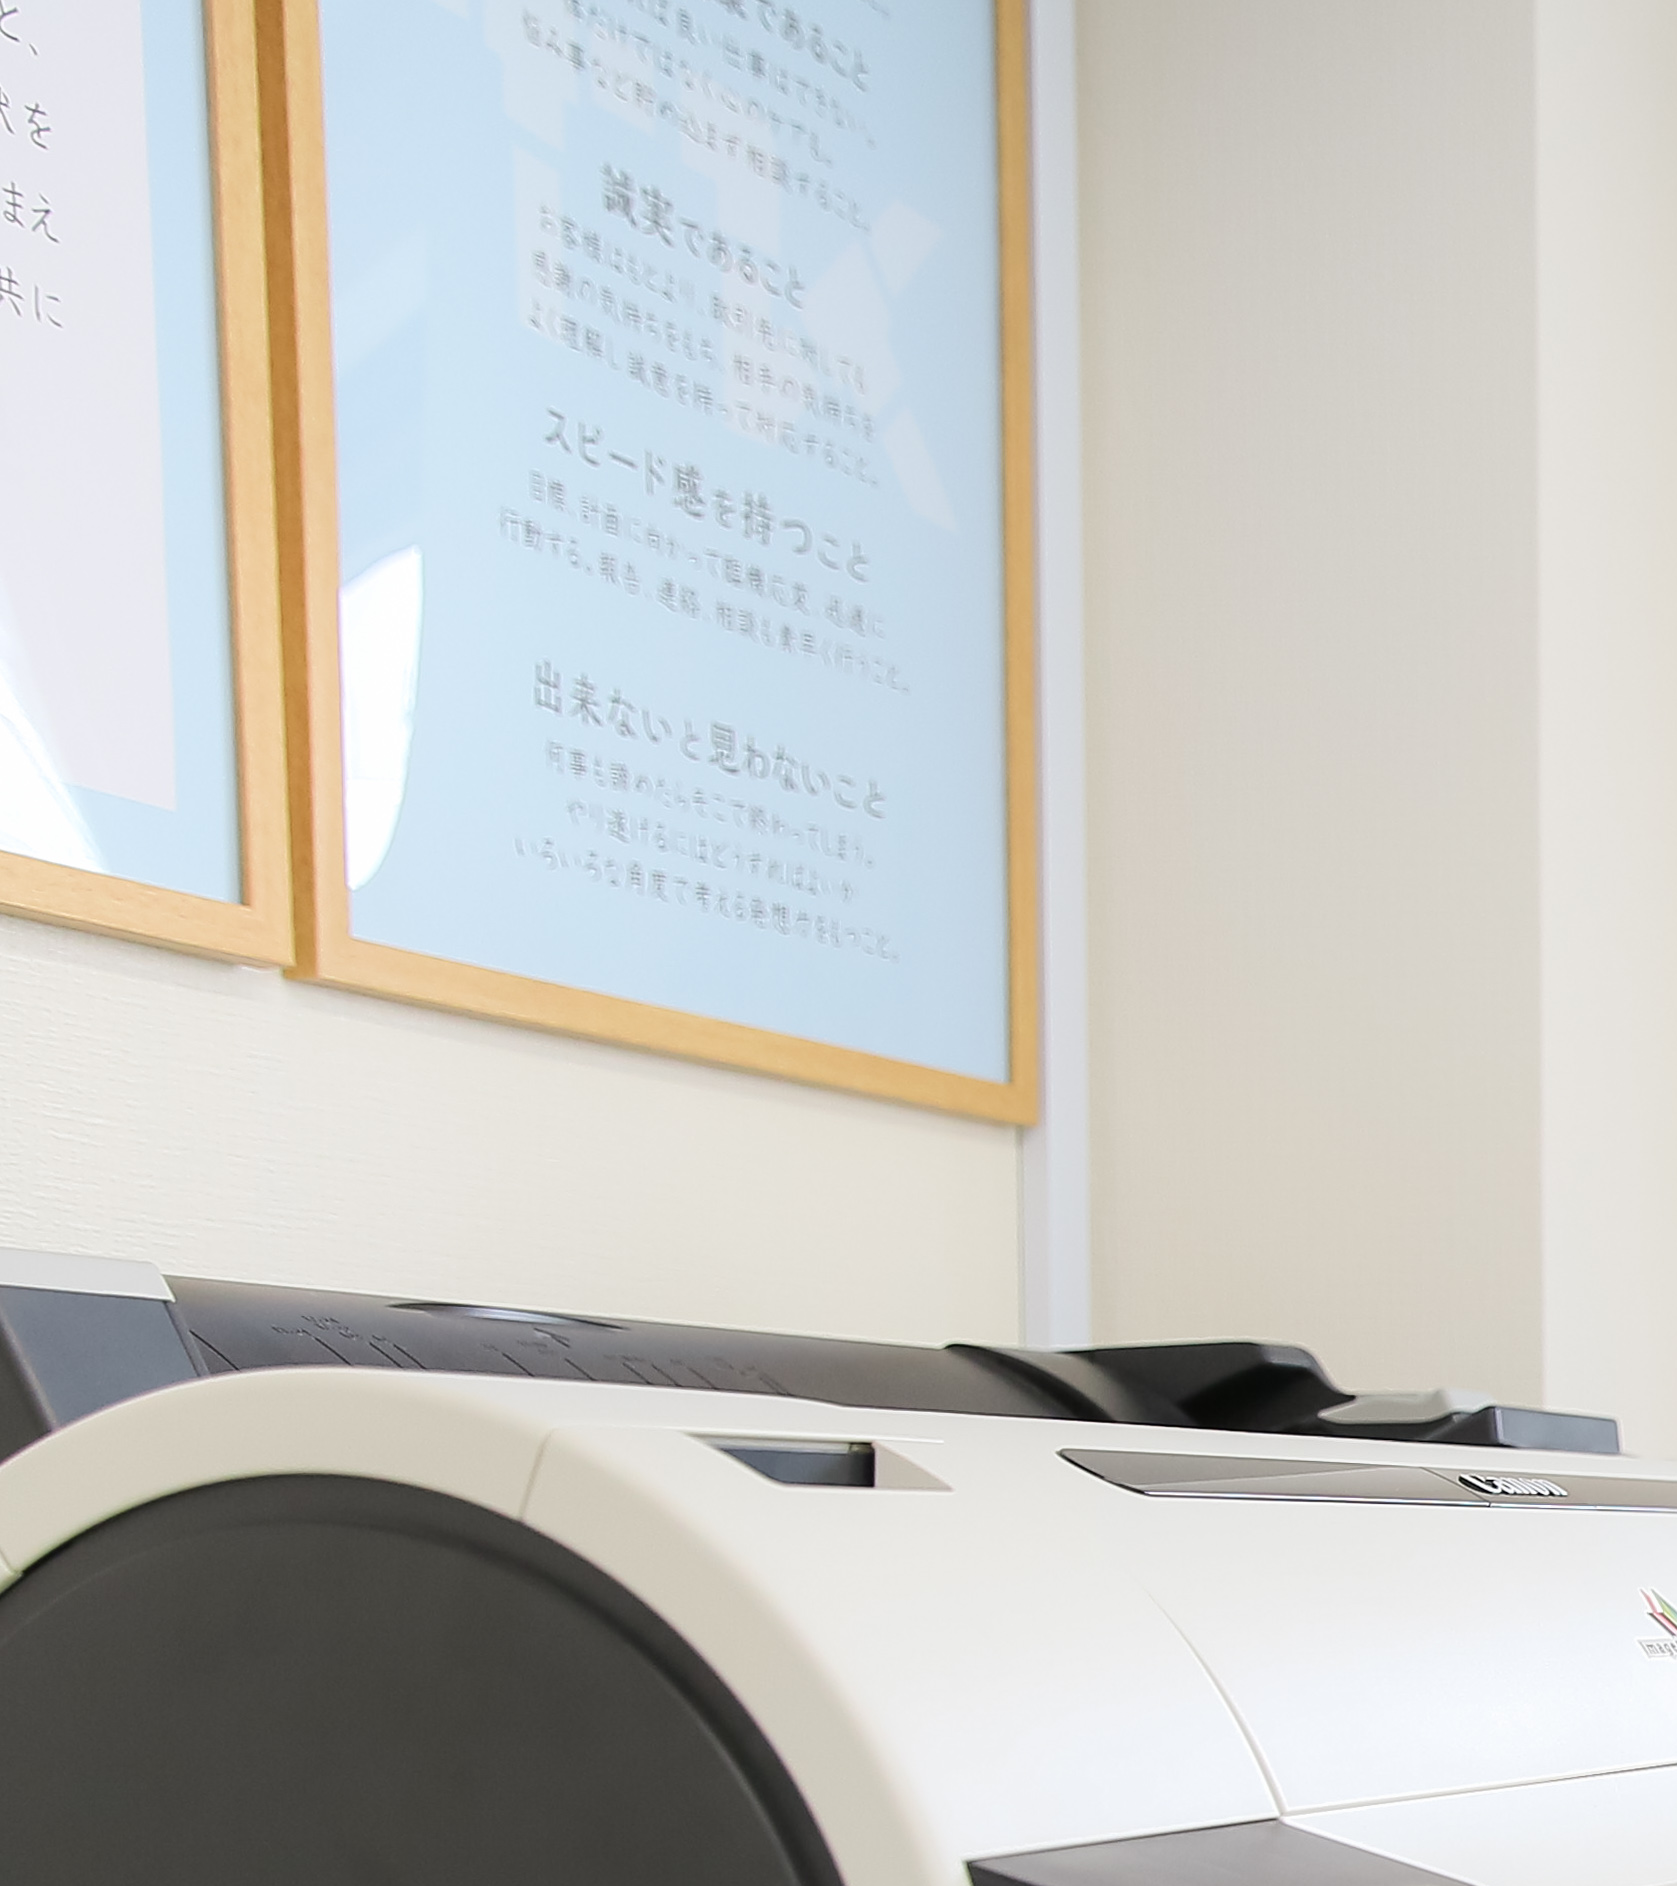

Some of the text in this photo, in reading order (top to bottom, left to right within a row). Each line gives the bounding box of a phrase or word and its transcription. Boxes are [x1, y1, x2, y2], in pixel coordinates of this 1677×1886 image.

[718, 0, 870, 93] であること
[600, 161, 804, 309] 誠実であること
[544, 406, 870, 584] スピード感を持つこと
[532, 657, 887, 820] 出来ないと思わないこと
